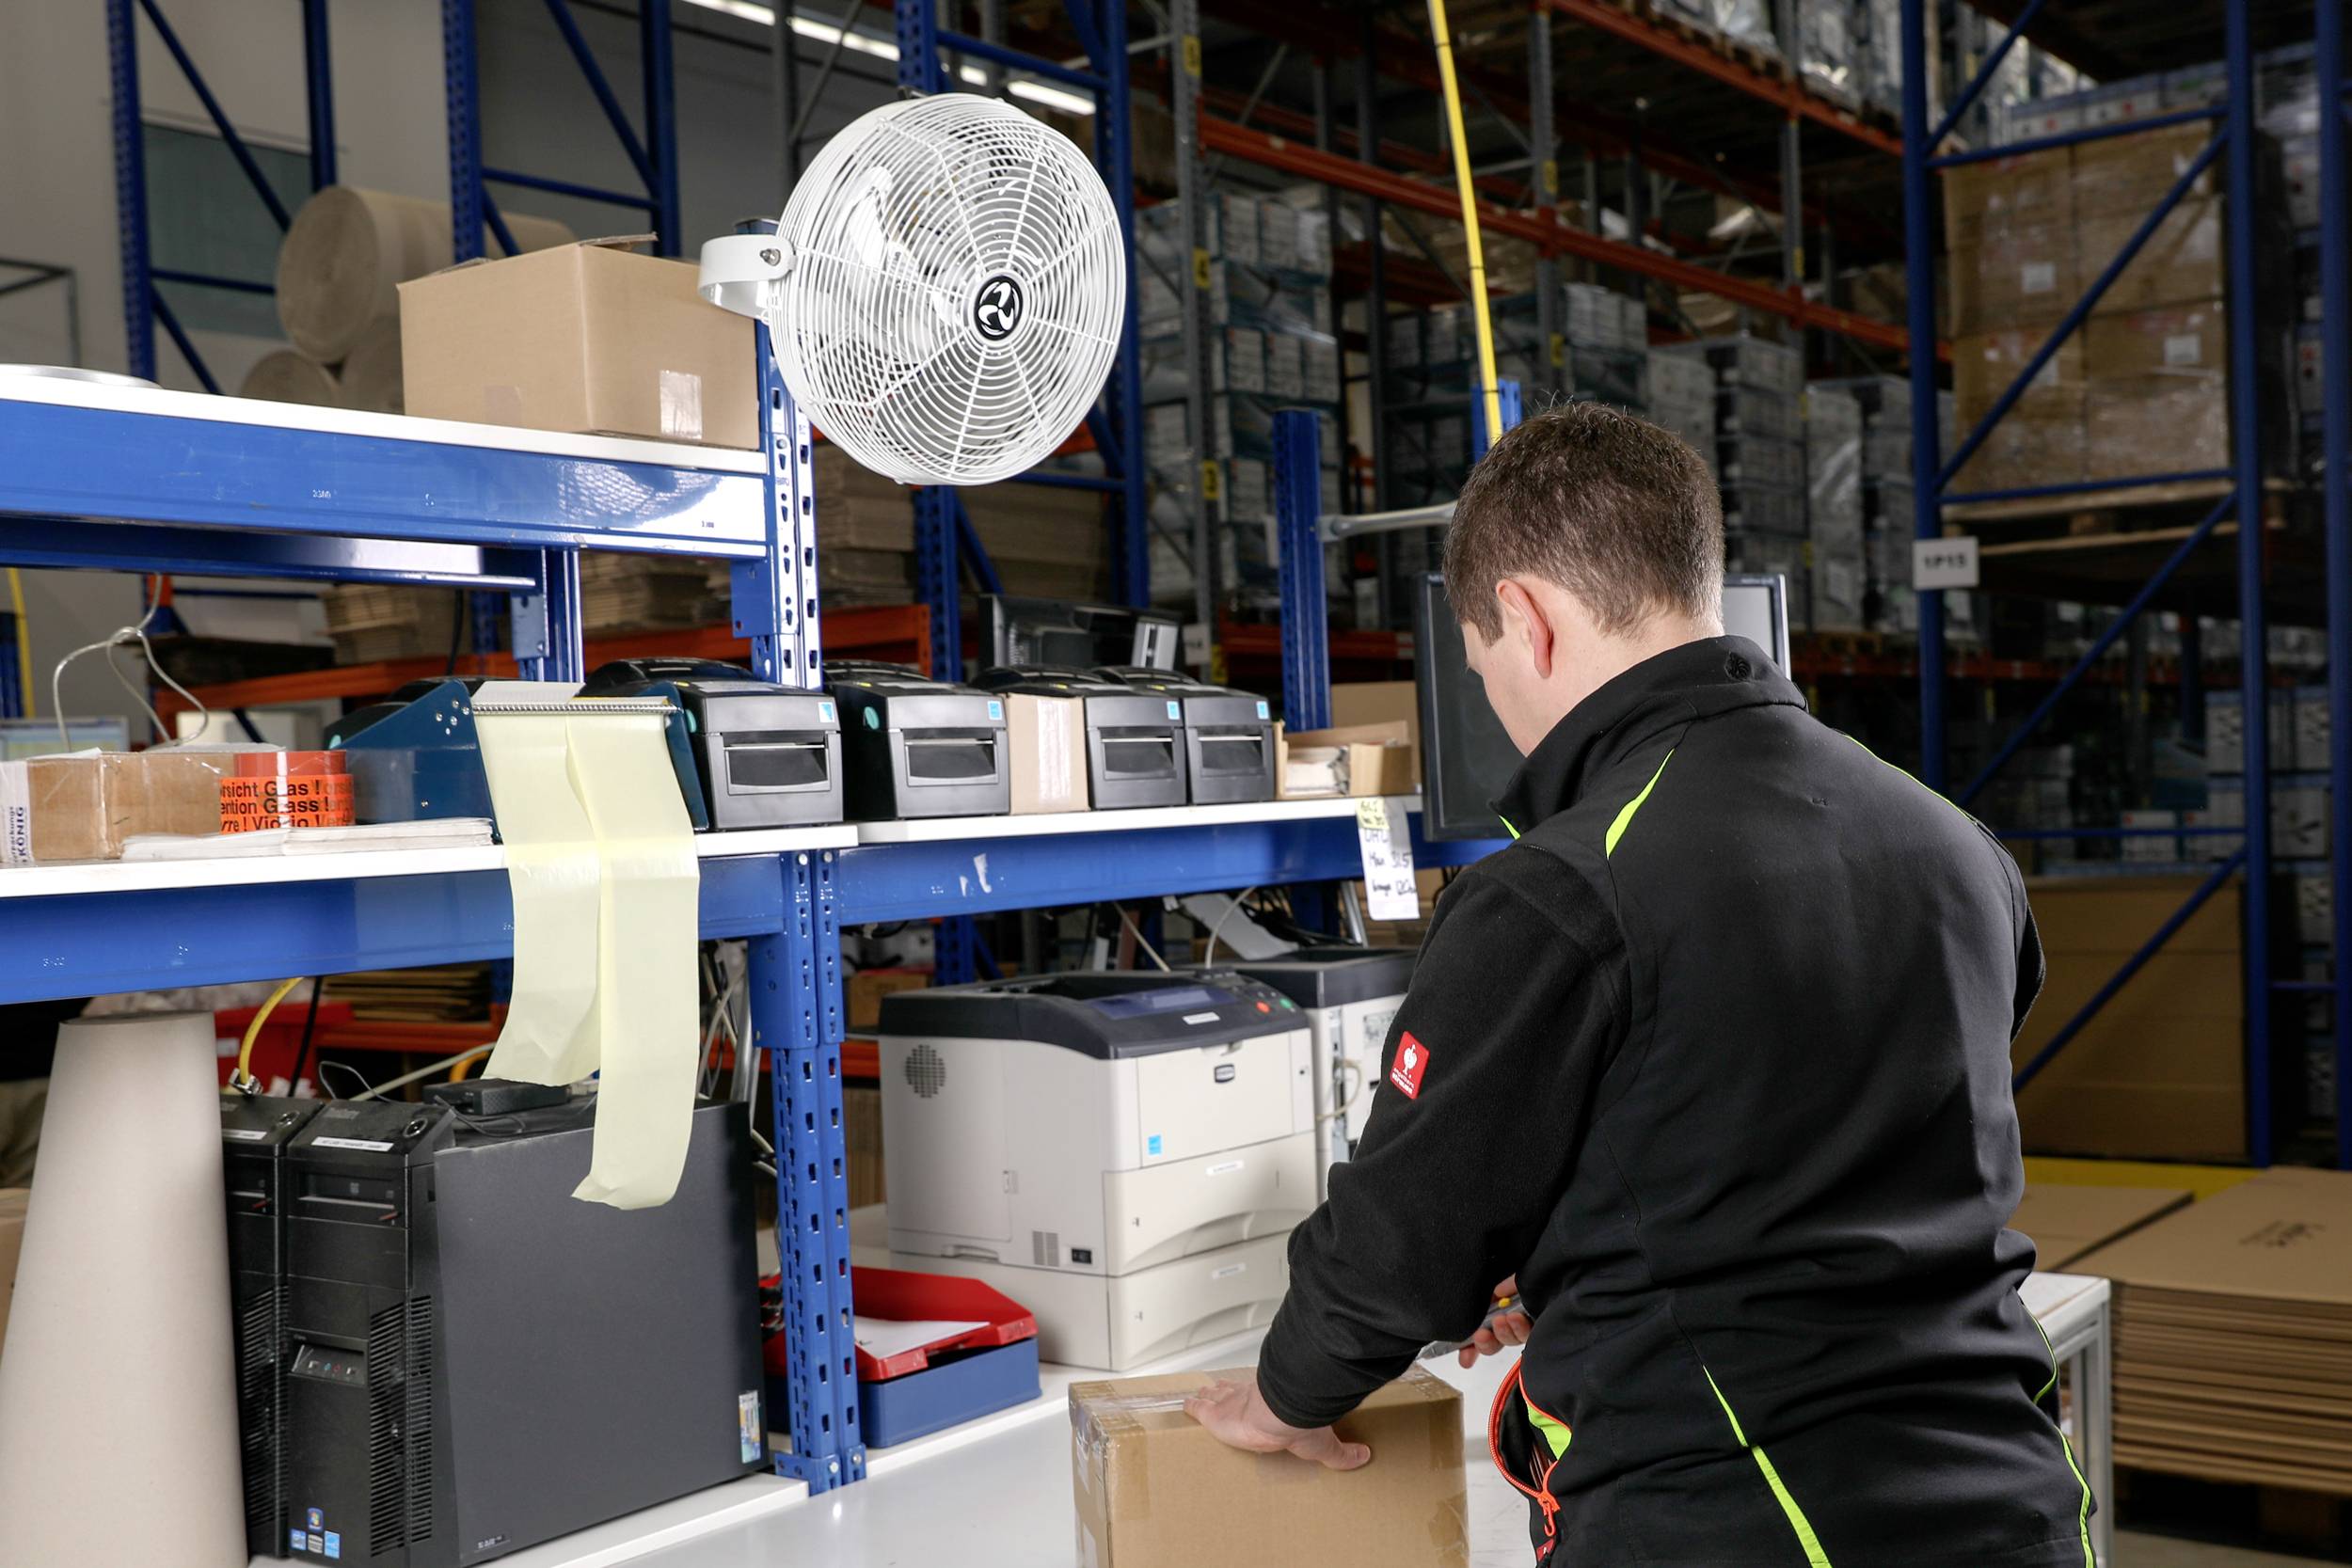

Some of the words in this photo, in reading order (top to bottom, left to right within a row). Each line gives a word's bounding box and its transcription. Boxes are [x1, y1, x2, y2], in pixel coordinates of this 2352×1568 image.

[220, 780, 260, 798] rsicht
[264, 781, 310, 797] Gas
[220, 800, 258, 815] ention
[263, 798, 319, 813] Gass
